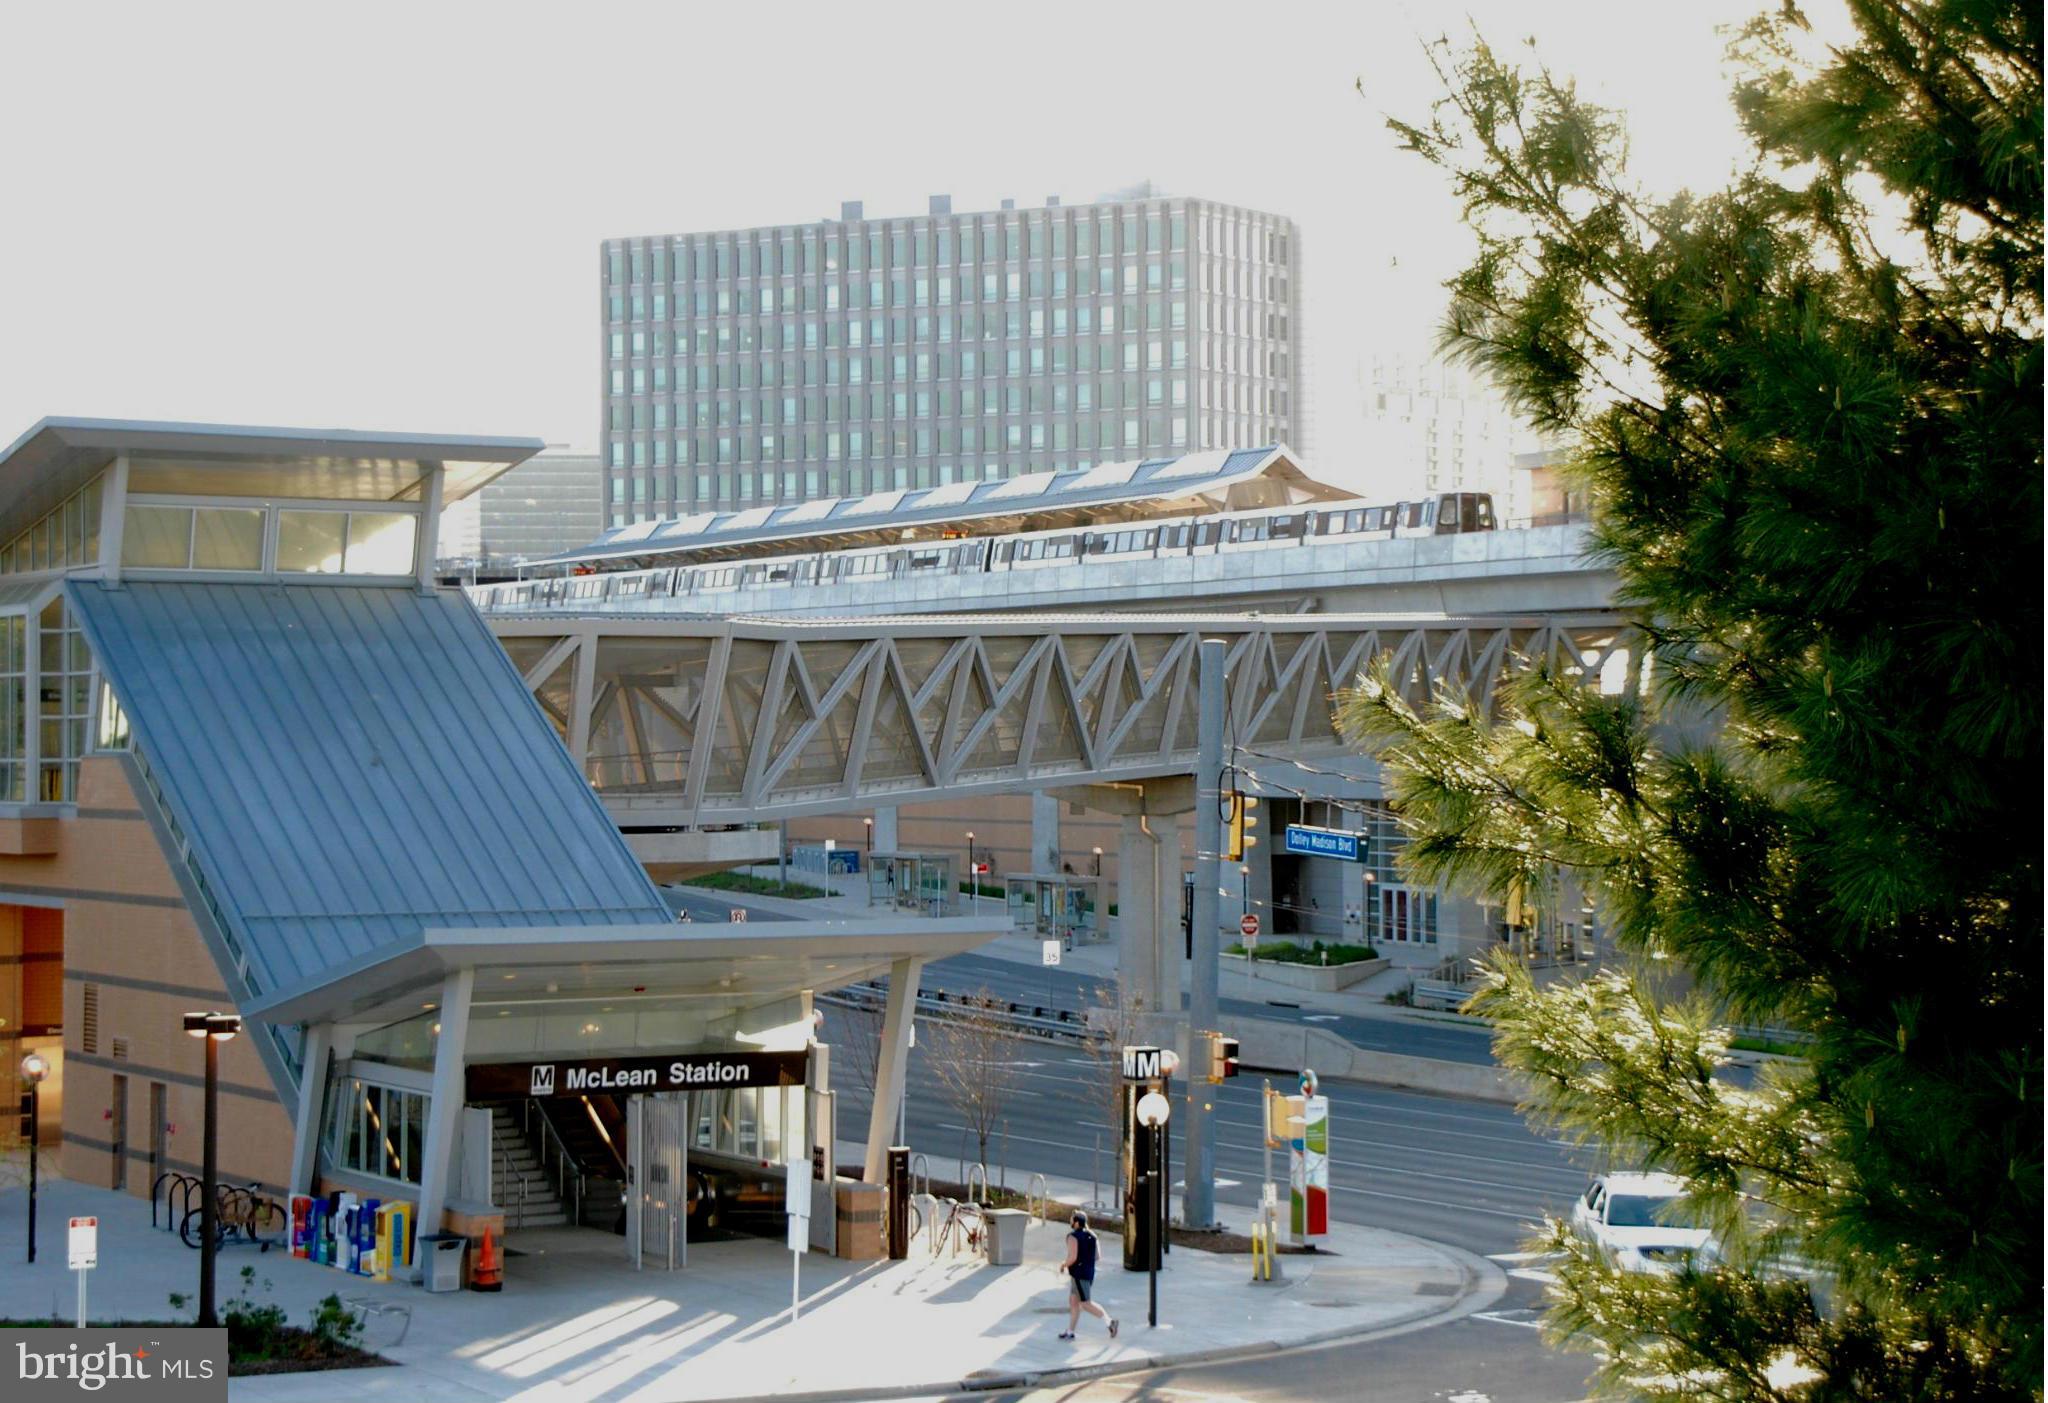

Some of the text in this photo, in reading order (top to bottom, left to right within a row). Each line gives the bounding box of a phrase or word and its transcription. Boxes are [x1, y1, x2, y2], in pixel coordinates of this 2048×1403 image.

[1311, 834, 1337, 850] Madison
[1338, 837, 1352, 853] Blvd
[534, 1061, 749, 1089] M McLean Station
[1137, 1052, 1160, 1077] M
